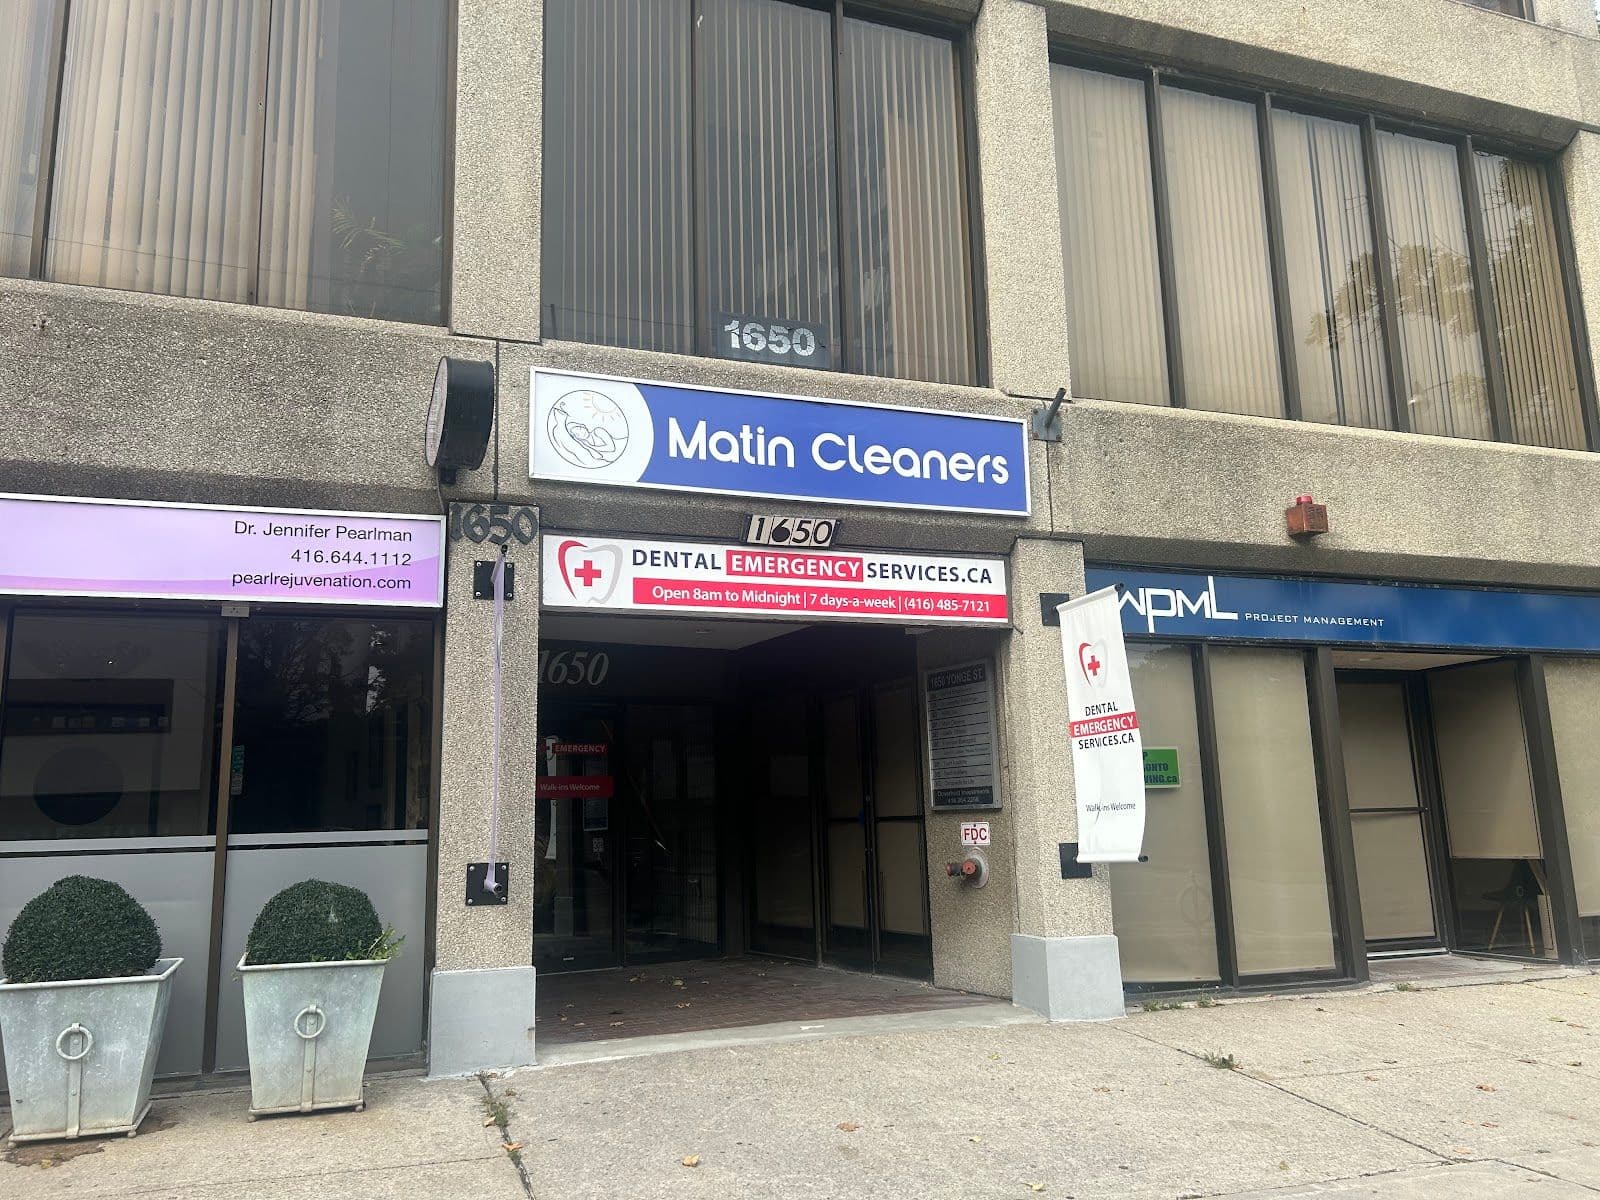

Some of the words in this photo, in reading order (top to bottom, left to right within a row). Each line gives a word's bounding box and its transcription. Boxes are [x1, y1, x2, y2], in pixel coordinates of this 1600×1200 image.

[724, 320, 816, 357] 1650
[667, 416, 795, 469] Matin
[811, 432, 1010, 485] Cleaners
[234, 520, 257, 535] Dr.
[263, 522, 331, 539] Jennifer
[336, 525, 412, 542] Pearlman
[449, 503, 539, 545] 1650
[755, 516, 832, 546] 1650
[290, 549, 412, 566] 416.644.1112
[632, 549, 722, 570] DENTAL
[731, 554, 860, 578] EMERGENCY
[867, 562, 992, 584] SERVICES.CA
[232, 572, 412, 590] pearlrejuvenation.com
[652, 585, 690, 601] Open
[693, 587, 722, 601] 8am
[725, 590, 739, 602] to
[742, 590, 800, 607] Midnight
[809, 593, 818, 605] 7
[820, 592, 896, 609] days-a-week
[904, 597, 934, 612] (416)
[936, 599, 990, 612] 485-7121
[1245, 612, 1299, 624] PROJECT
[1303, 615, 1385, 627] MANAGEMENT
[538, 650, 609, 686] 1650
[1085, 701, 1118, 717] DENTAL
[1073, 715, 1134, 736] EMERGENCY
[554, 744, 606, 753] EMERGENCY
[1078, 732, 1135, 750] SERVICES.CA
[540, 783, 569, 792] Walk-ins
[569, 782, 600, 792] Welcome
[1110, 801, 1136, 812] Welcome
[963, 827, 988, 841] FDC
